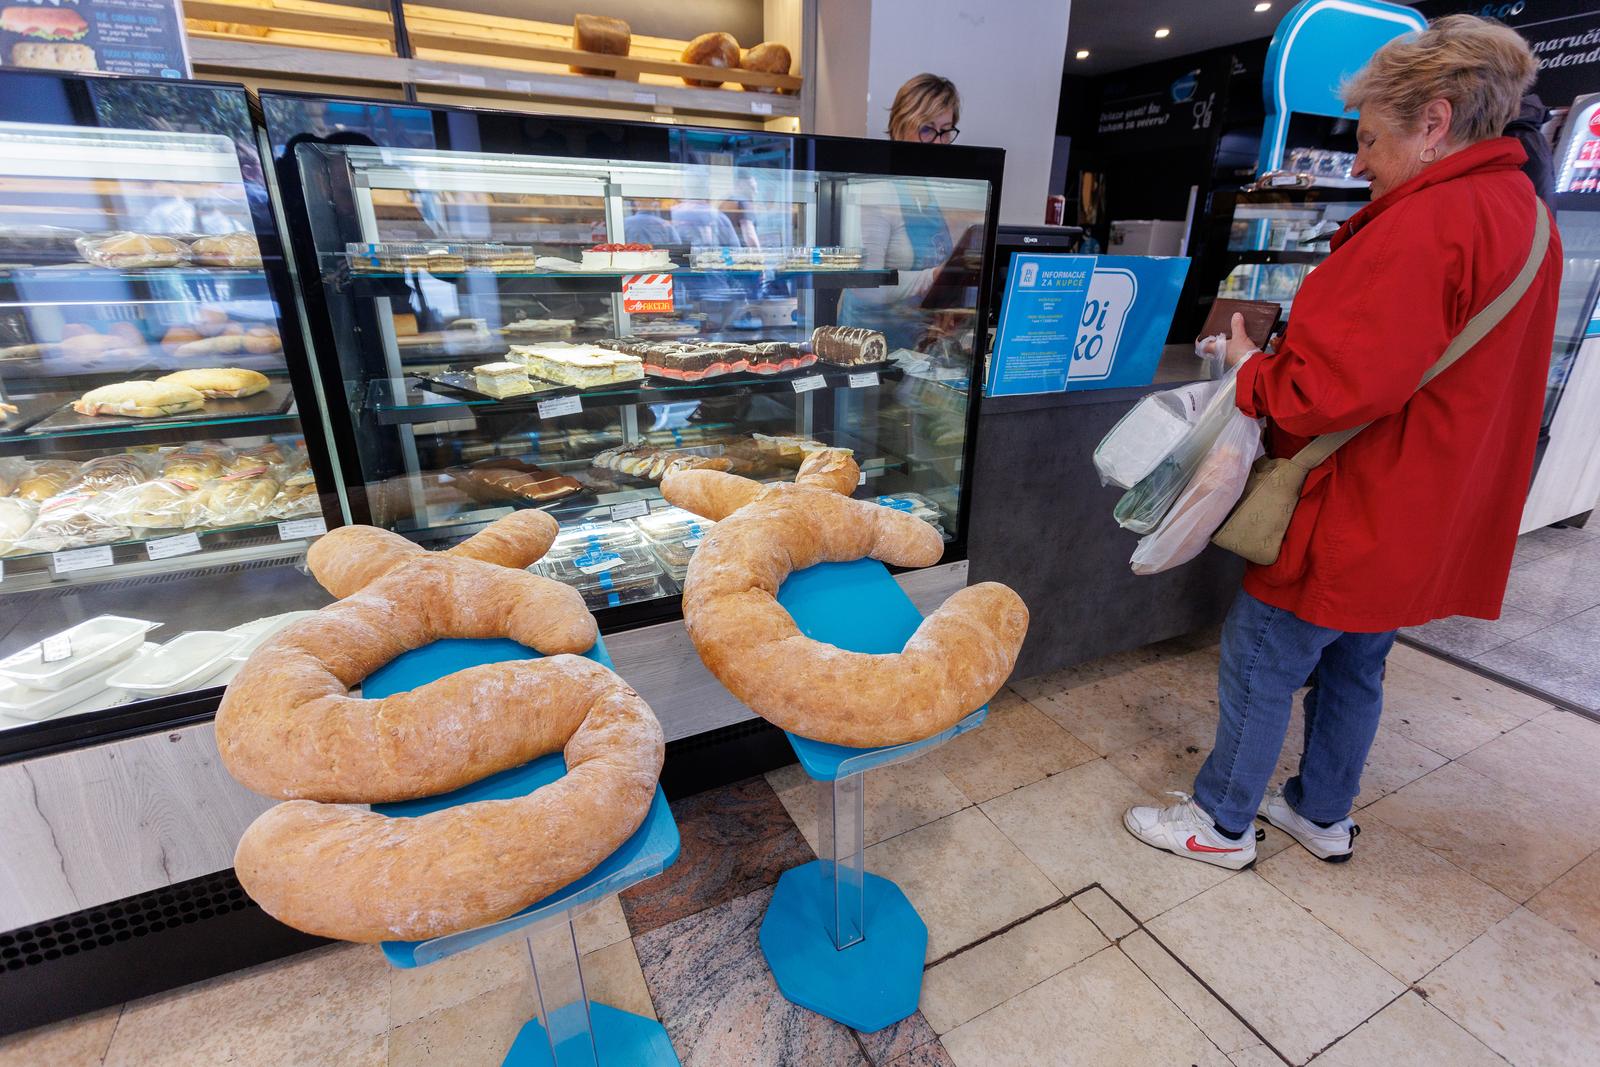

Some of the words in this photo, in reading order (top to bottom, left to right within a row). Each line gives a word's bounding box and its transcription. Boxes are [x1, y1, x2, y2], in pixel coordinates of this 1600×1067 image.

[1532, 28, 1600, 53] naruči
[1042, 271, 1087, 279] INFORMACIJE
[1041, 279, 1053, 287] ZA
[1056, 279, 1084, 287] KUPCE
